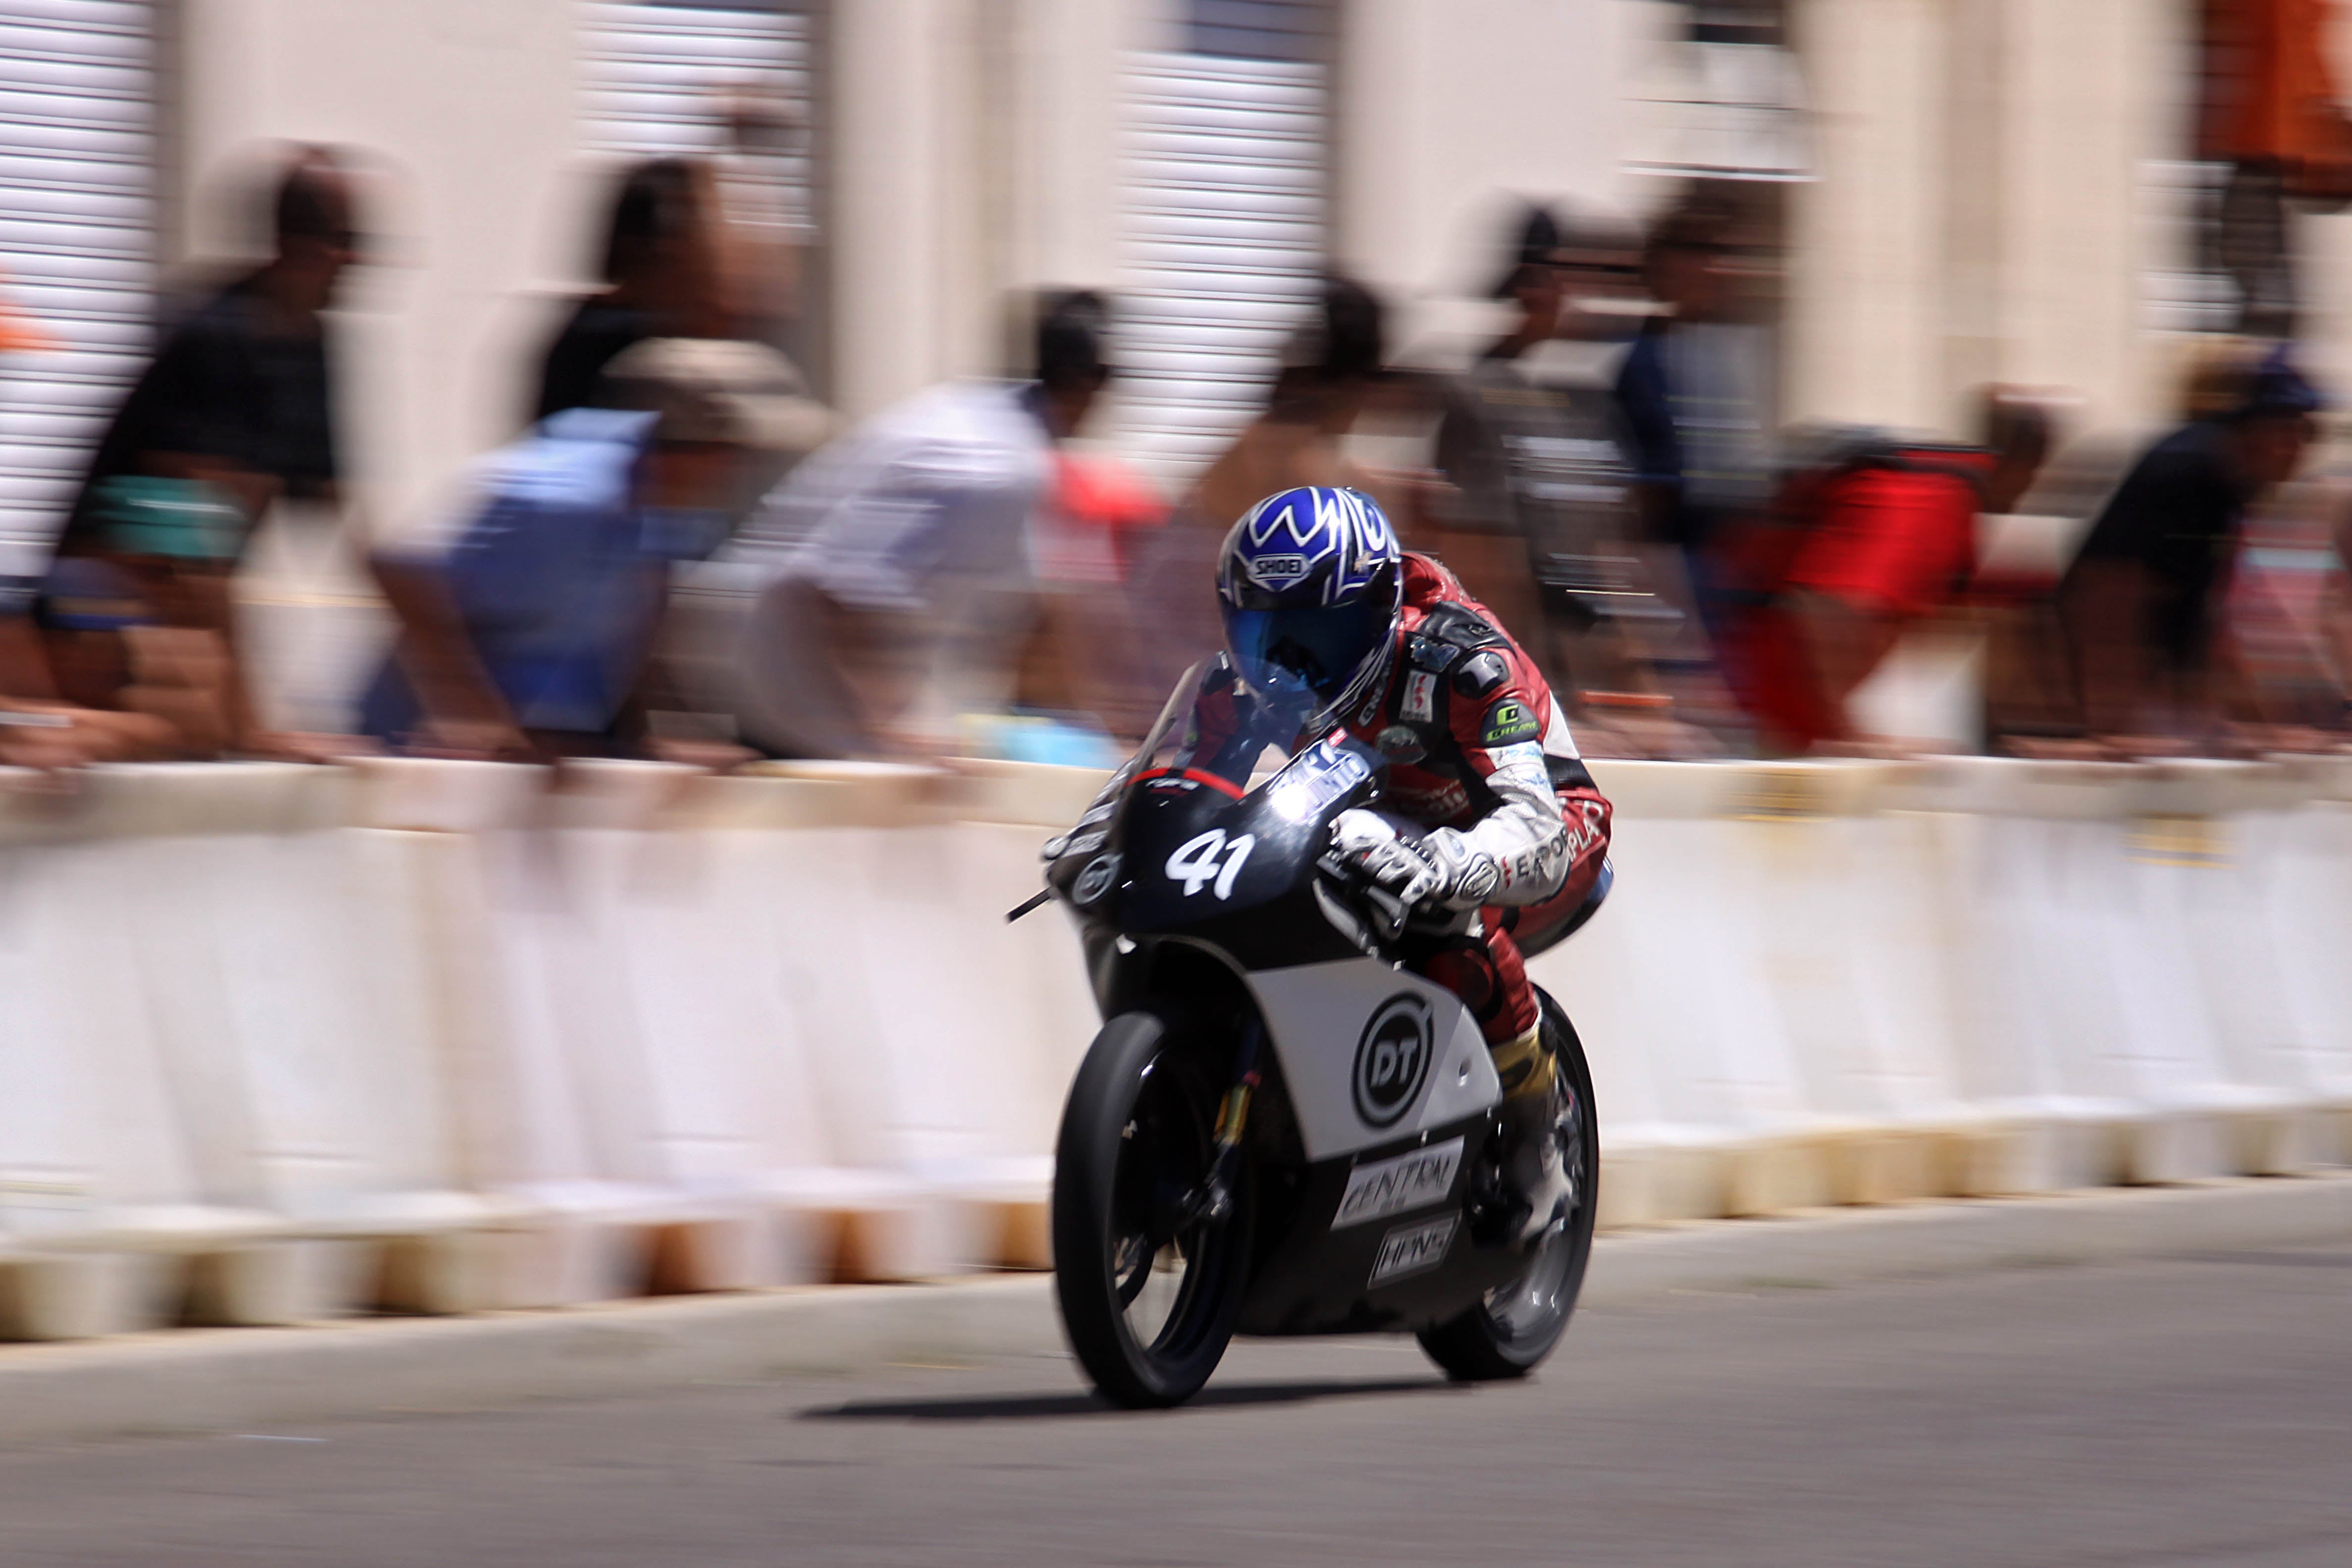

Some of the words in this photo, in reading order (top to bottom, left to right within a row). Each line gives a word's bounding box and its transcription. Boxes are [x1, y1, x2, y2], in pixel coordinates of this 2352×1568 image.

[1256, 559, 1301, 575] SHOEI
[1165, 828, 1256, 901] 41
[1370, 1038, 1419, 1087] DT
